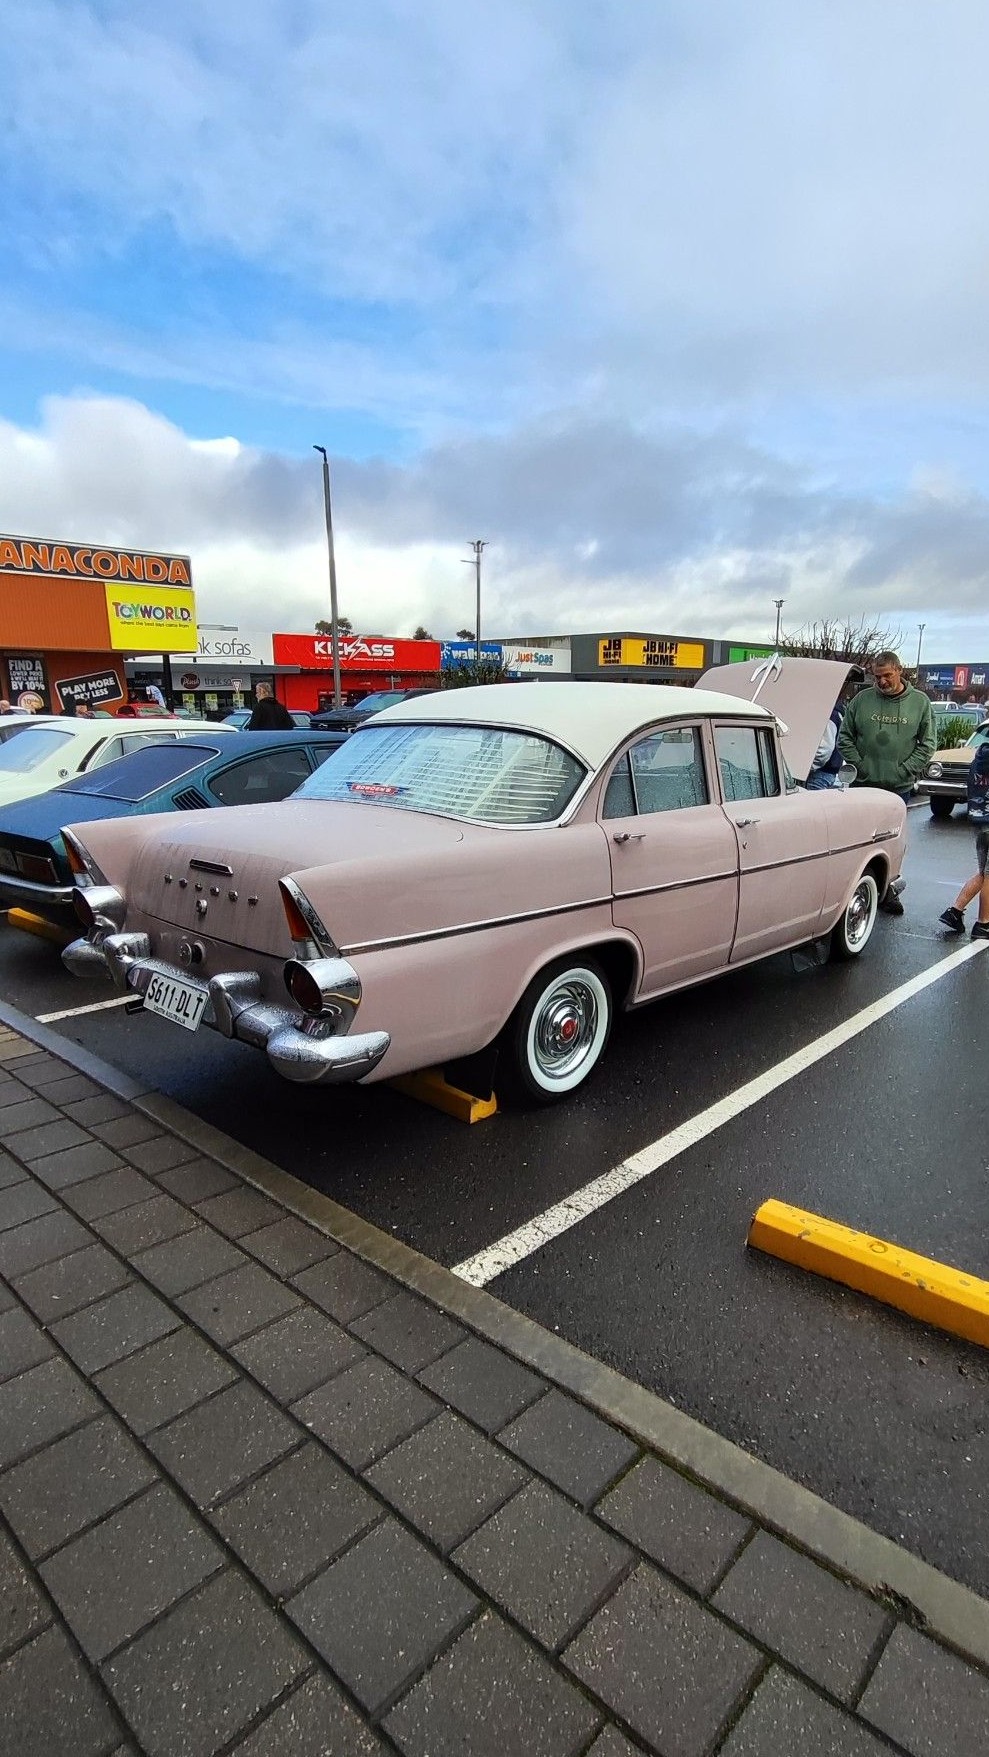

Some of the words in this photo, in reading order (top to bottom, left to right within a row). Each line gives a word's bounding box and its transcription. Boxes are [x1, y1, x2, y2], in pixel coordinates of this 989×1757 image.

[0, 540, 190, 585] ANACONDA
[111, 601, 190, 621] TOYWORLD
[215, 638, 251, 655] sofas
[314, 638, 395, 659] KICKASS
[603, 640, 621, 650] JB
[643, 641, 657, 653] JB
[8, 659, 33, 671] FIND
[35, 660, 43, 671] A
[646, 654, 675, 666] HOME
[11, 681, 24, 690] BY
[25, 681, 45, 690] 10%
[61, 683, 87, 696] PLAY
[88, 677, 116, 690] MORE
[91, 688, 109, 698] LESS
